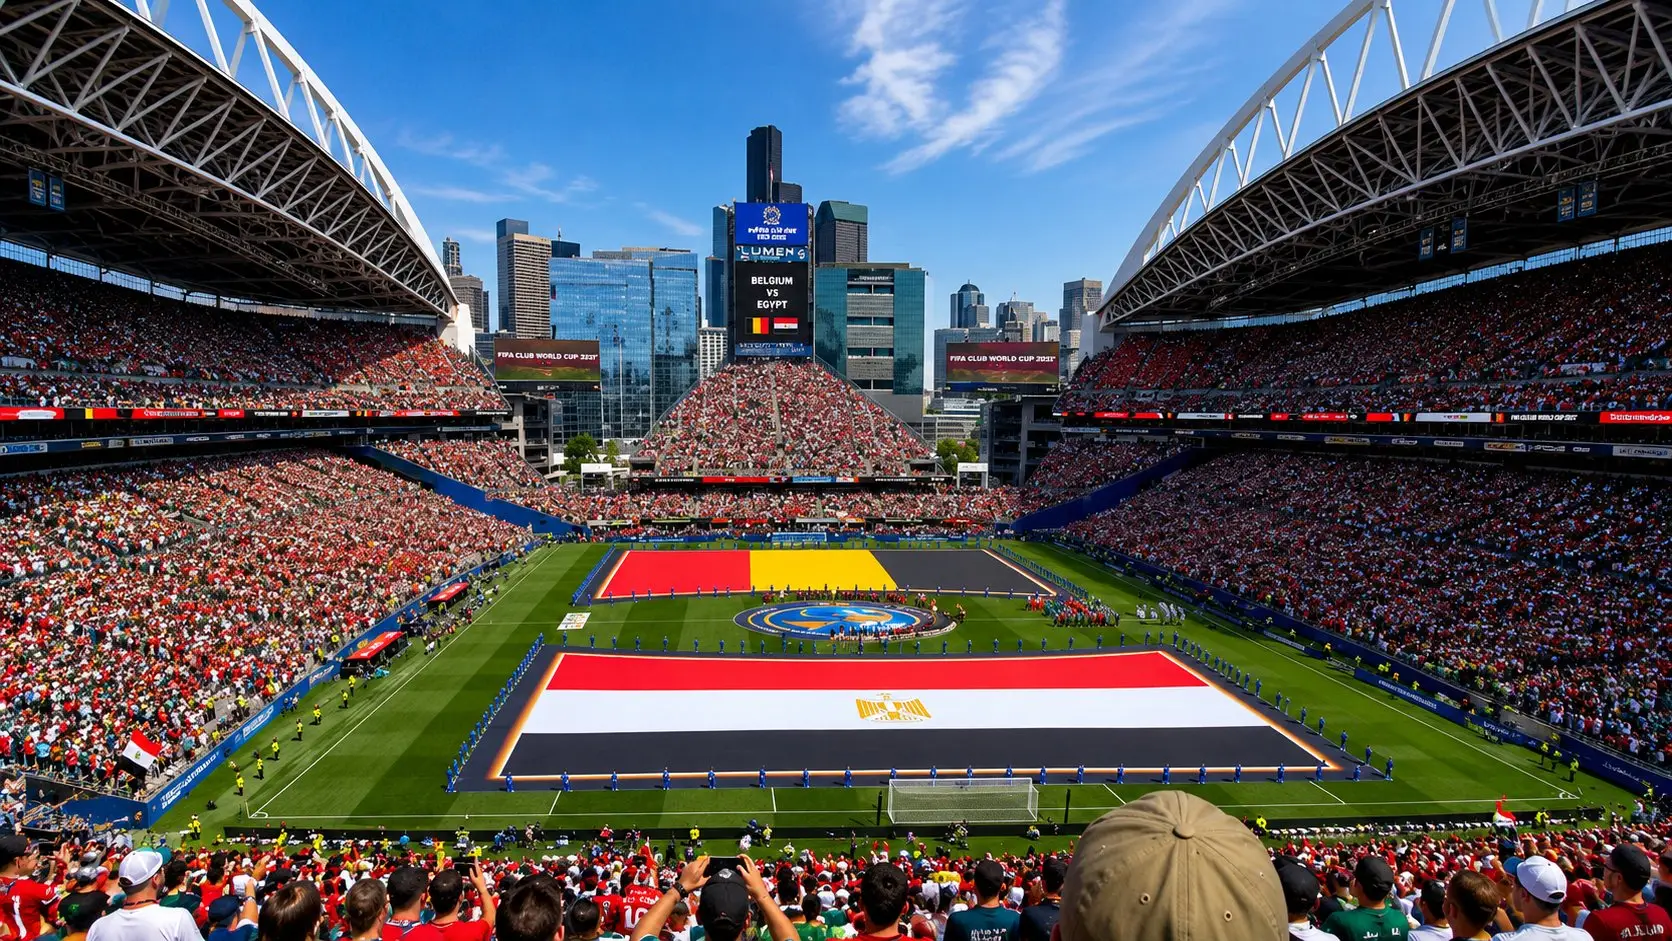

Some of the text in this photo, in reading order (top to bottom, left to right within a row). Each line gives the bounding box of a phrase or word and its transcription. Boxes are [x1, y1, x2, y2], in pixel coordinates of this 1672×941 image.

[751, 276, 793, 285] BELGIUM
[766, 288, 779, 297] VS
[757, 300, 788, 309] EGYPT
